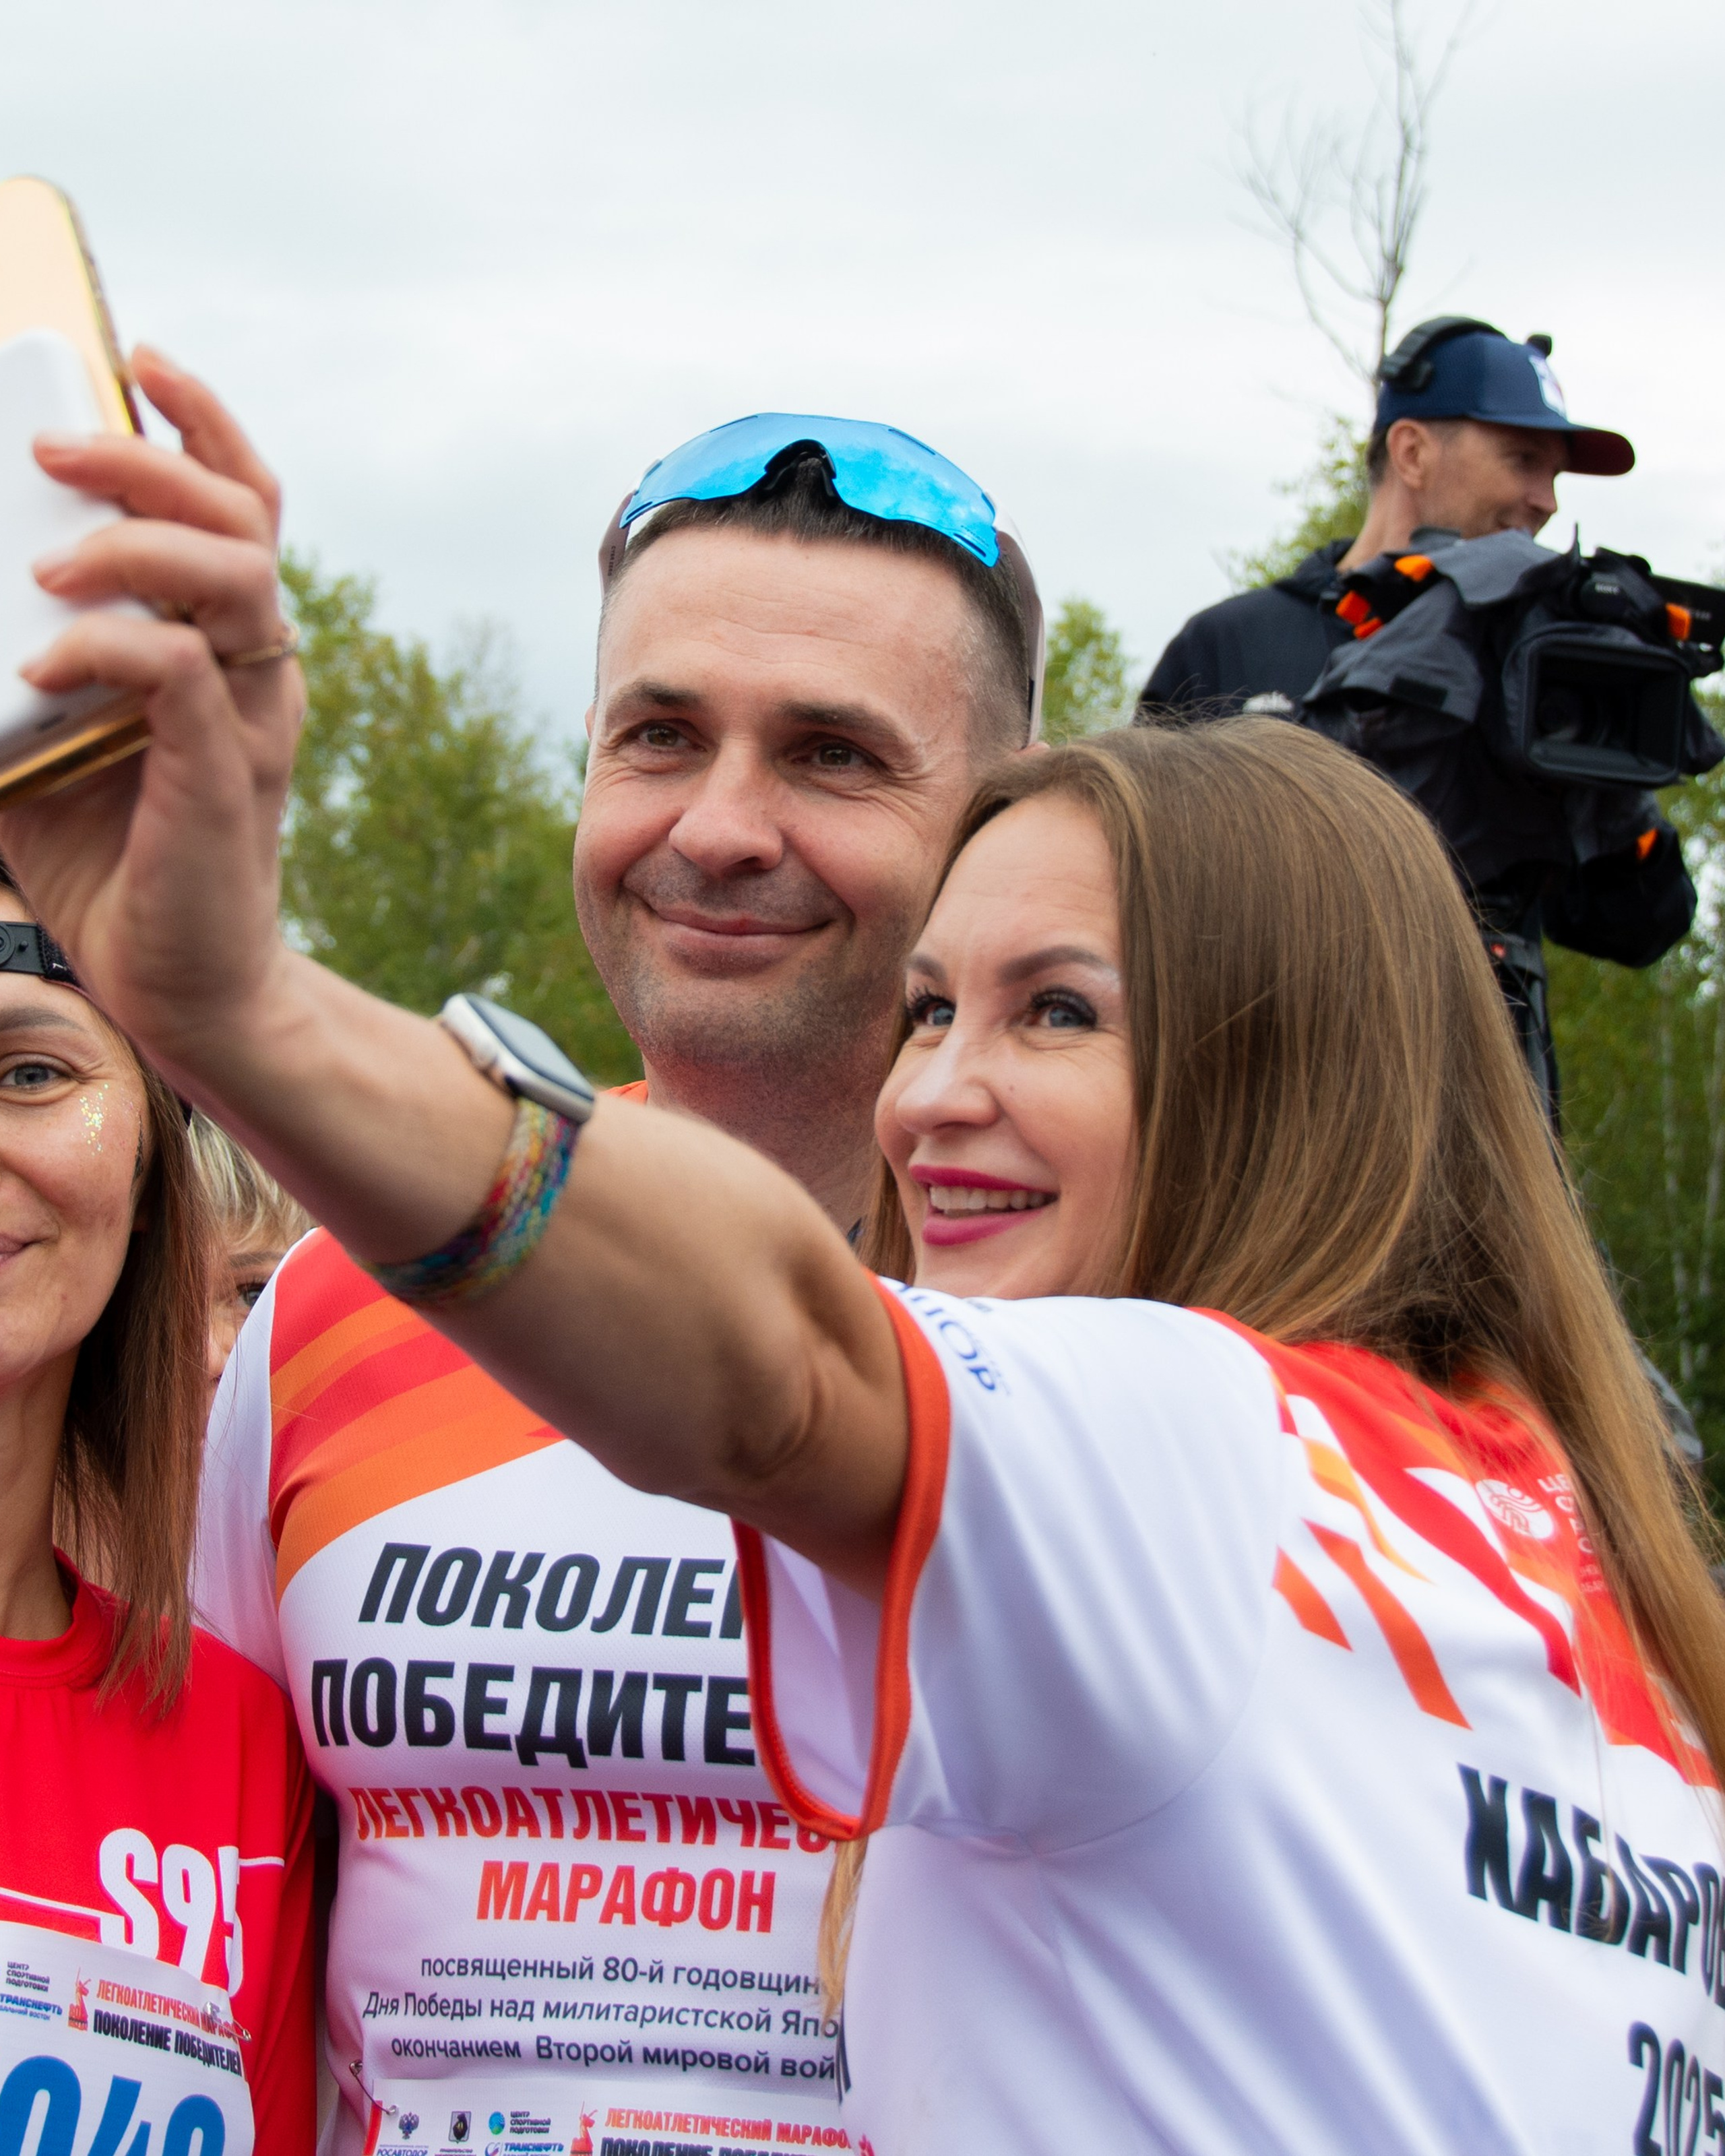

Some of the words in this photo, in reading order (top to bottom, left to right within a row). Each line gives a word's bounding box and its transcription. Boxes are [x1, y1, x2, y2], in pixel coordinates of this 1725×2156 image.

[476, 1860, 776, 1933] МАРАФОН
[1456, 1761, 1725, 2011] ХАБАРО
[421, 1957, 594, 1981] посвященный
[602, 1956, 664, 1984] 80-й
[94, 2008, 172, 2052] ПОКОЛЕНИЕ
[363, 1992, 399, 2018] Дня
[404, 1992, 482, 2020] Победы
[490, 1999, 535, 2021] над
[542, 2001, 772, 2032] милитаристской
[782, 2009, 839, 2038] Япо
[391, 2038, 522, 2058] окончанием
[536, 2035, 633, 2066] Второй
[643, 2046, 770, 2074] мировой
[780, 2056, 834, 2079] вой
[605, 2107, 772, 2141] ЛЕГКОАТЛЕТИЧЕСКИЙ
[776, 2122, 852, 2149] МАРАФО
